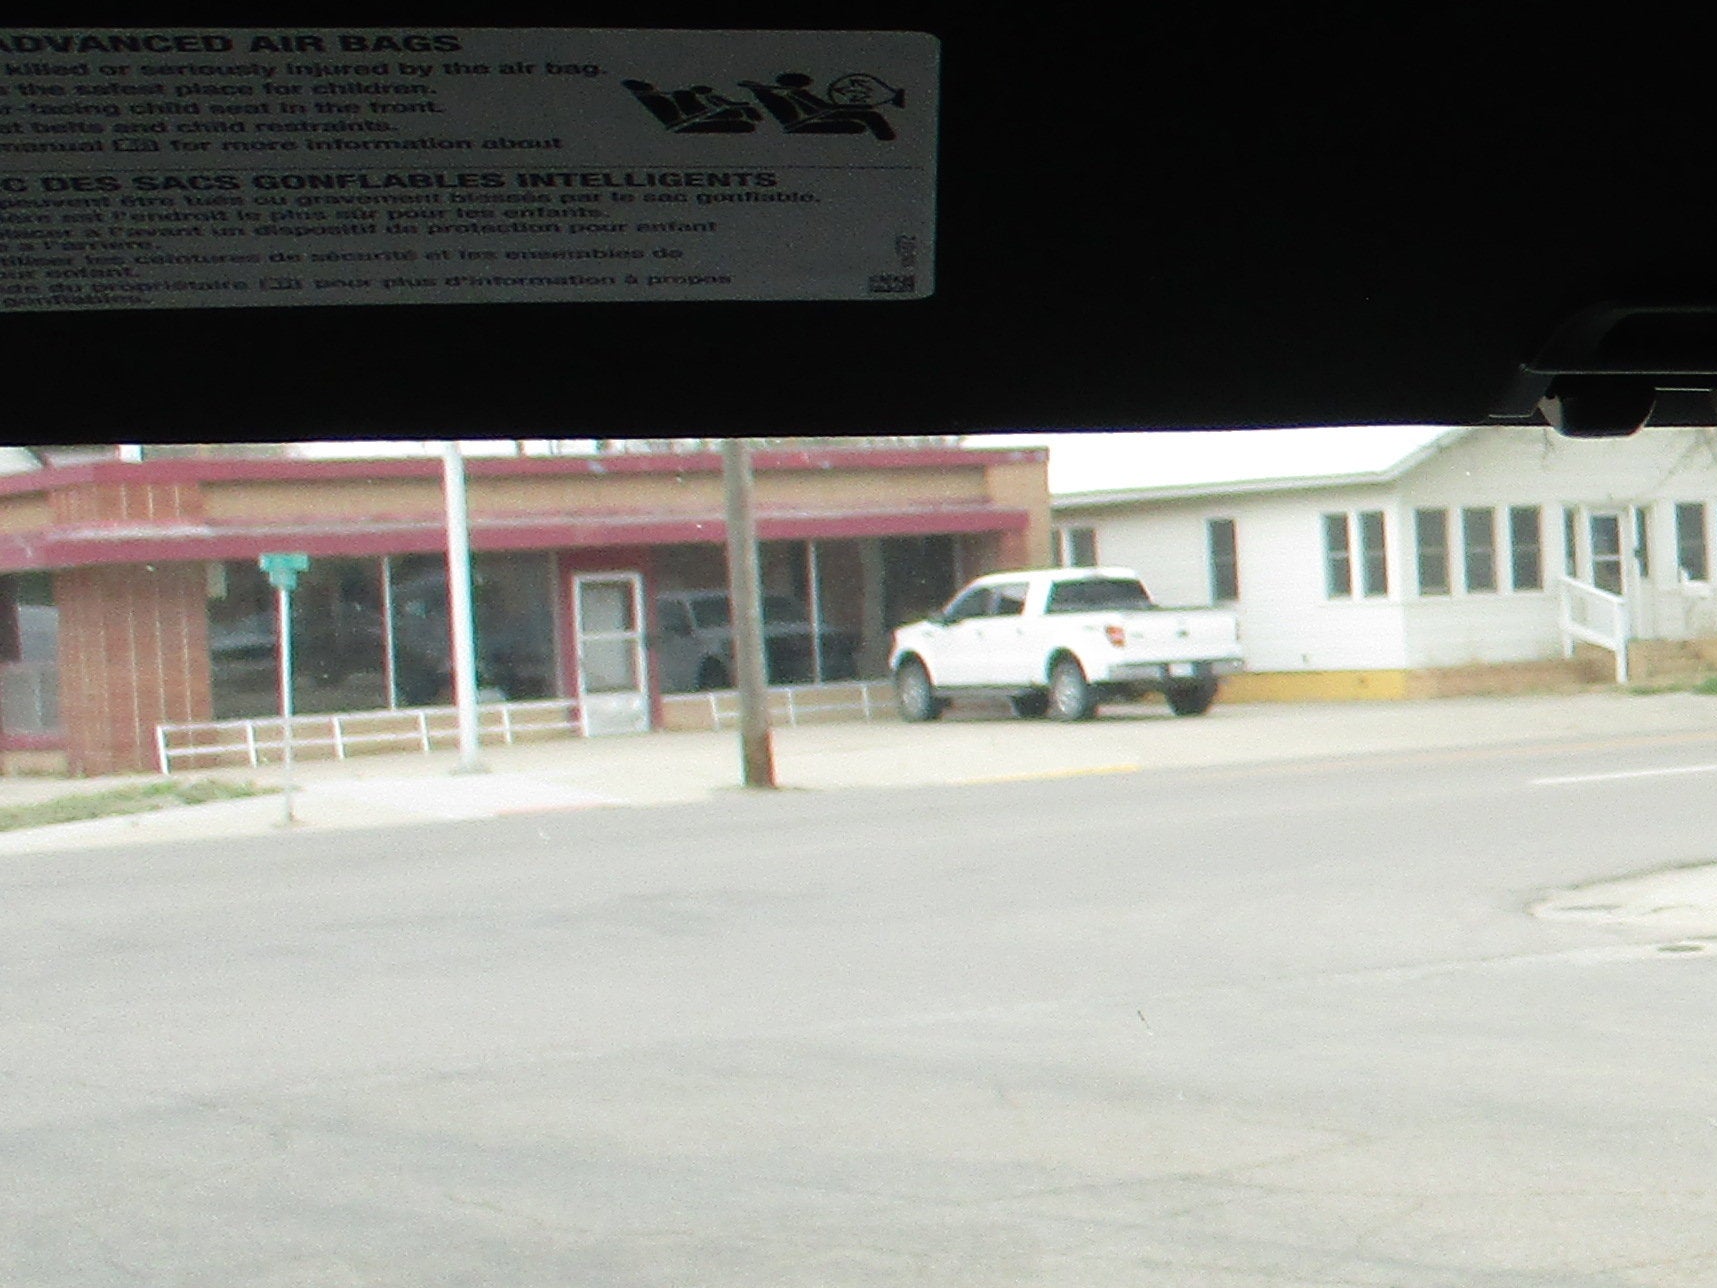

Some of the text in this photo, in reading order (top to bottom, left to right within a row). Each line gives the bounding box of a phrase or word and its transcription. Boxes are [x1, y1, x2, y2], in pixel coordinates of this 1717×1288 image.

[249, 35, 326, 52] AIR
[338, 34, 463, 53] BAGS
[5, 62, 608, 78] killed or seriously injured by the air bag.
[16, 83, 65, 96] the
[75, 83, 164, 96] safest
[174, 83, 253, 98] place
[262, 83, 303, 95] for
[312, 82, 438, 95] children.
[0, 101, 446, 118] r-facing child seat in the front.
[30, 121, 105, 134] belts
[111, 121, 169, 134] and
[176, 121, 246, 133] child
[254, 120, 399, 133] restraints.
[169, 139, 213, 152] for
[221, 140, 299, 152] more
[306, 137, 473, 151] information
[480, 137, 564, 150] about
[0, 172, 778, 193] C DES SACS GONFLABLES INTELLIGENTS
[387, 210, 448, 222] pour
[636, 221, 718, 233] enfant
